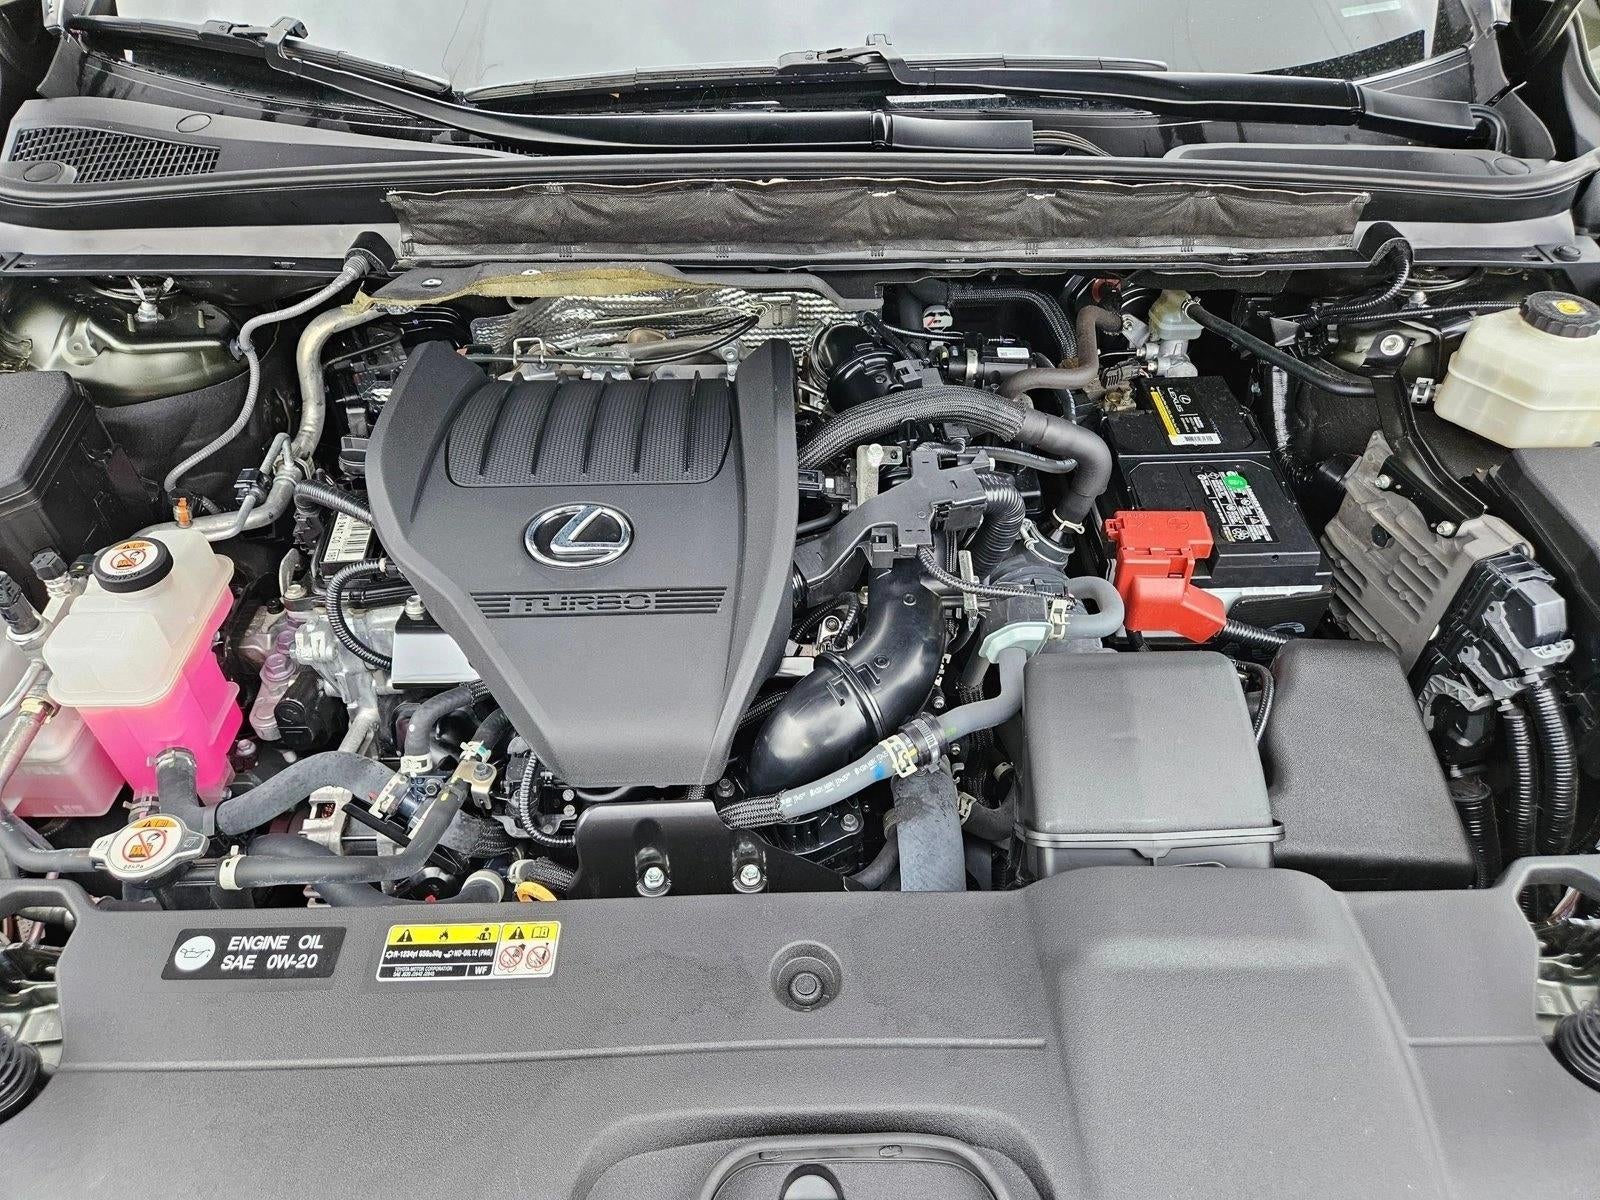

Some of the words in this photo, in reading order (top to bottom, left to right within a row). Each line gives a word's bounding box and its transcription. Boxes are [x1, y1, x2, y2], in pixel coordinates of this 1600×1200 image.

[1167, 387, 1184, 412] LEXUS
[514, 593, 651, 612] TURBO
[227, 935, 290, 951] ENGINE
[298, 934, 324, 950] OIL
[220, 954, 257, 971] SAE
[266, 953, 319, 969] 0W-20
[475, 965, 488, 975] WF
